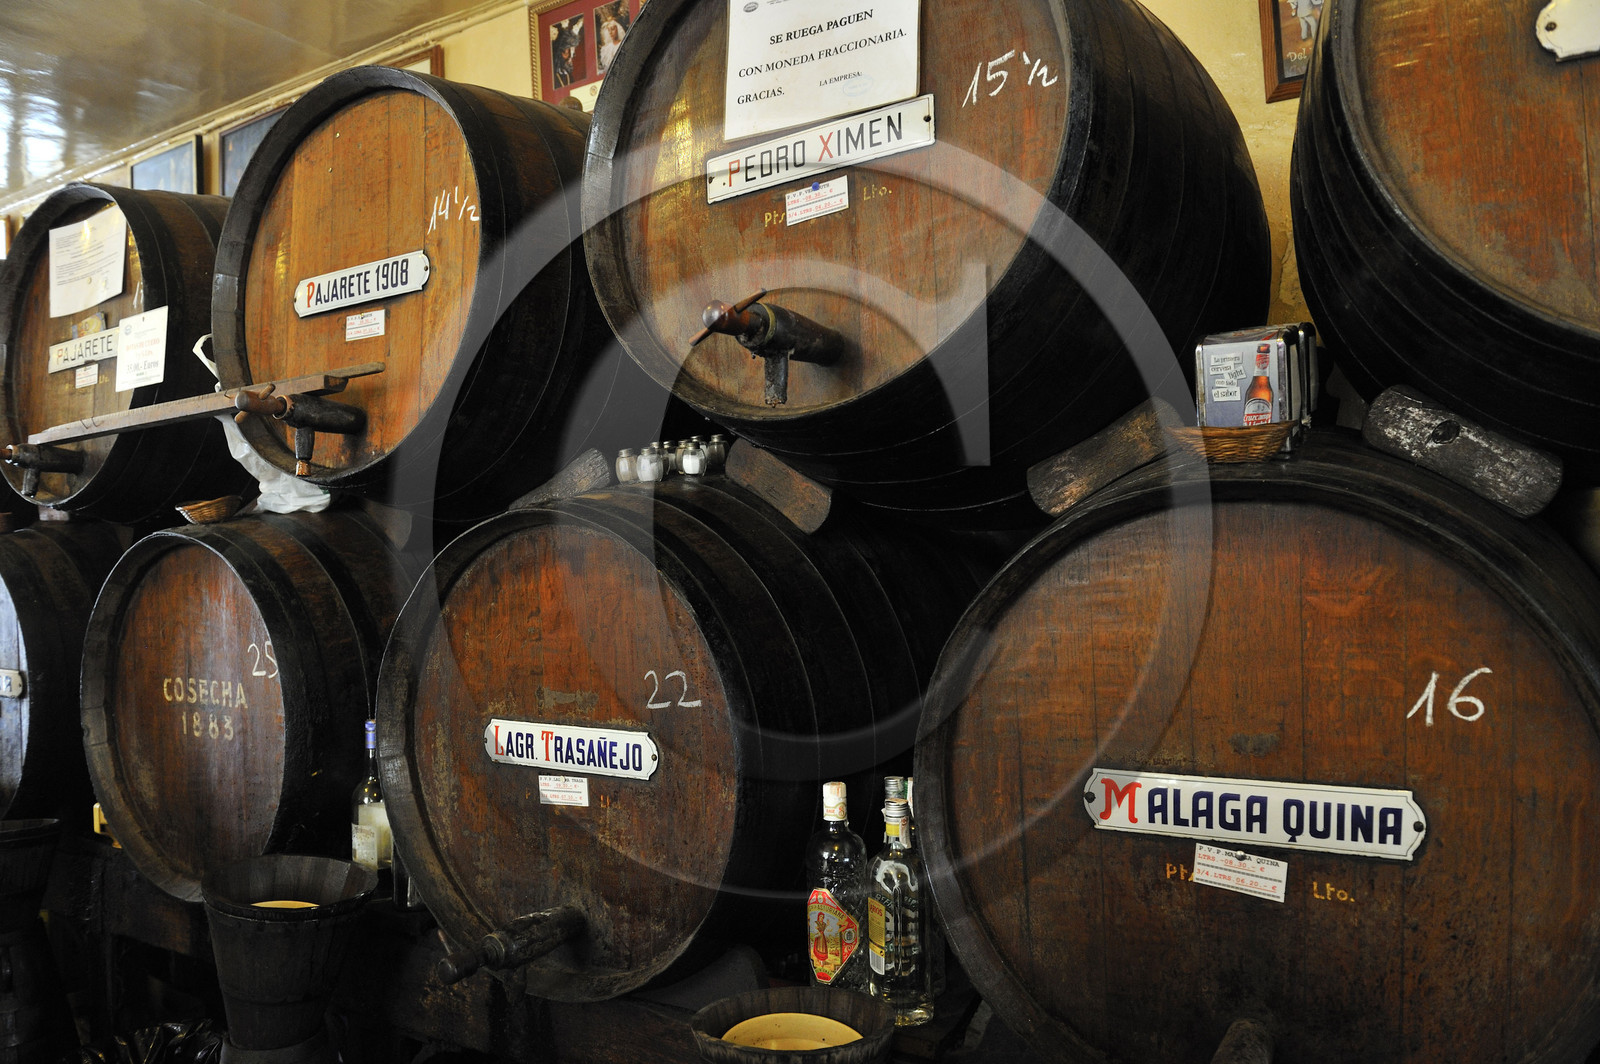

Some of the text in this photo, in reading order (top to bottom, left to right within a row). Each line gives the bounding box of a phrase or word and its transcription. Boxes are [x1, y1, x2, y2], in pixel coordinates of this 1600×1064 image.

[769, 9, 874, 45] SE RUEGA PAGUEN
[738, 28, 907, 78] CON MONEDA FRACCIONARIA.
[737, 87, 785, 105] GRACIAS.
[819, 79, 828, 87] LA
[961, 49, 1015, 108] 15
[728, 112, 902, 187] PEDRO XIMEN
[427, 189, 451, 235] 14
[307, 258, 409, 308] PAJARETE 1908
[57, 334, 113, 365] PAJARETE
[247, 640, 278, 679] 25
[163, 677, 248, 709] COSECHA
[643, 669, 702, 709] 22
[1406, 667, 1493, 727] 16
[182, 711, 234, 741] 1883
[494, 725, 643, 772] LAGR. TRASAÑEJO
[1100, 777, 1403, 846] MALAGA QUINA
[1256, 857, 1280, 868] QUINA
